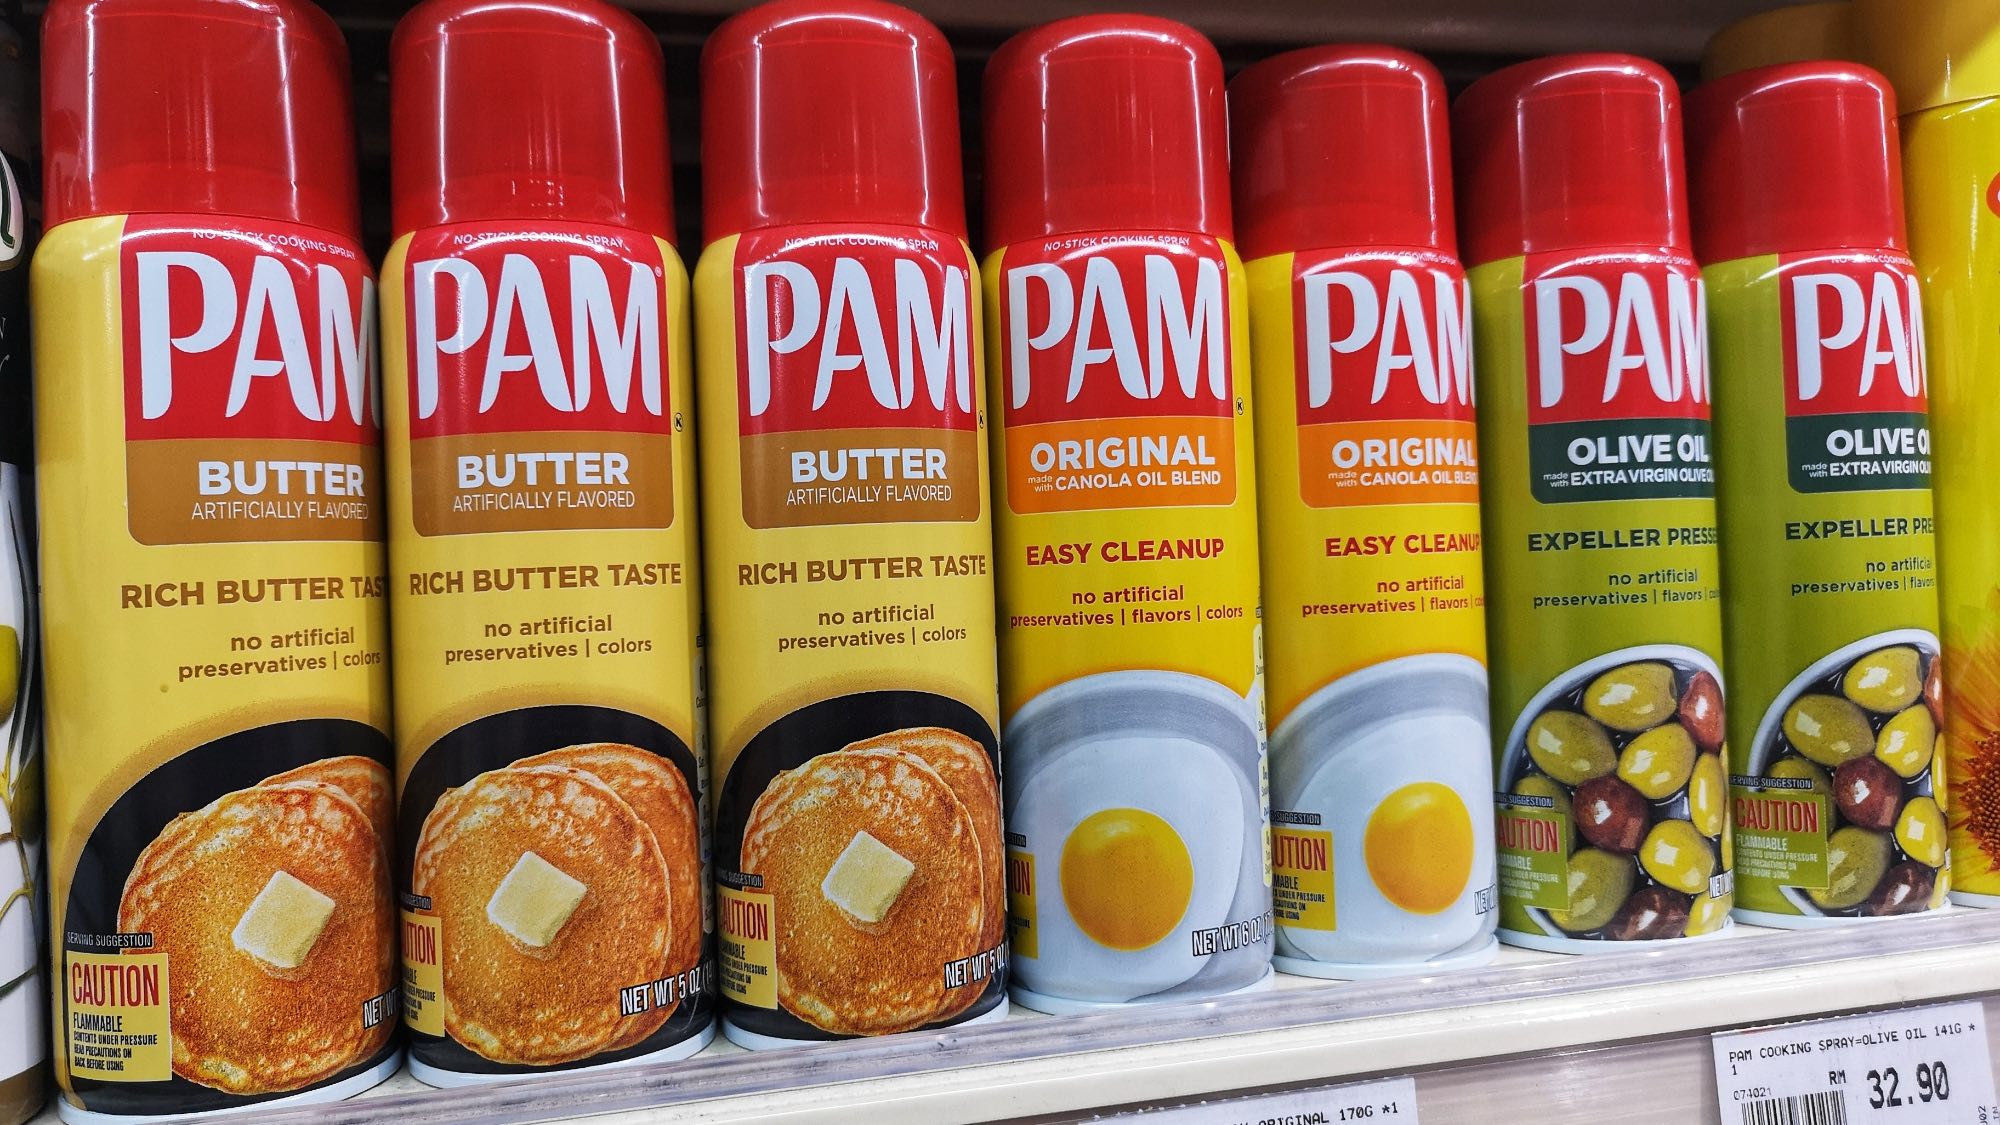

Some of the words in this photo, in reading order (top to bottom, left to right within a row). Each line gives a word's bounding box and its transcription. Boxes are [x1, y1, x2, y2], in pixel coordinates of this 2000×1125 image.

[268, 234, 327, 252] COOKING
[327, 244, 356, 260] SPRAY
[454, 232, 513, 245] NO-STICK
[585, 236, 624, 248] SPRAY
[908, 239, 939, 251] SPRAY
[1044, 237, 1097, 252] NO-STICK
[1100, 235, 1155, 246] COOKING
[1158, 235, 1189, 246] SPRAY
[136, 251, 381, 429] PAM
[413, 253, 662, 420] PAM
[743, 257, 971, 416] PAM
[1007, 254, 1226, 410] PAM
[1303, 269, 1476, 408] PAM
[1534, 272, 1711, 408] PAM
[1030, 435, 1216, 473] ORIGINAL
[1331, 437, 1477, 469] ORIGINAL
[1567, 434, 1672, 465] OLIVE
[1676, 434, 1710, 463] OIL
[1826, 428, 1915, 457] OLIVE
[457, 452, 630, 489] BUTTER
[791, 448, 947, 483] BUTTER
[1328, 471, 1357, 479] made
[1543, 471, 1568, 480] made
[1571, 470, 1630, 486] EXTRA
[1629, 468, 1678, 484] VIRGIN
[1679, 467, 1707, 482] OLIVE
[1801, 462, 1828, 470] made
[1809, 470, 1828, 478] with
[1829, 461, 1884, 477] EXTRA
[1883, 460, 1919, 474] VIRGIN
[198, 460, 366, 497] BUTTER
[1028, 475, 1053, 485] made
[1034, 482, 1053, 493] with
[1055, 473, 1131, 491] CANOLA
[1136, 472, 1167, 487] OIL
[1171, 470, 1221, 486] BLEND
[1336, 479, 1357, 488] with
[1360, 471, 1429, 486] CANOLA
[1432, 470, 1453, 484] OIL
[1550, 479, 1569, 488] with
[453, 492, 553, 512] ARTIFICIALLY
[557, 490, 635, 508] FLAVORED
[786, 486, 881, 506] ARTIFICIALLY
[886, 484, 952, 502] FLAVORED
[191, 501, 304, 520] ARTIFICIALLY
[307, 501, 368, 520] FLAVORED
[1528, 528, 1660, 552] EXPELLER
[1785, 517, 1908, 540] EXPELLER
[1026, 543, 1092, 566] EASY
[1101, 538, 1225, 562] CLEANUP
[1325, 535, 1396, 557] EASY
[1403, 533, 1480, 554] CLEANUP
[738, 561, 798, 585] RICH
[807, 556, 923, 582] BUTTER
[930, 555, 986, 576] TASTE
[1608, 574, 1632, 586] no
[1638, 569, 1698, 585] artificial
[1866, 561, 1886, 573] no
[409, 571, 464, 595] RICH
[473, 565, 599, 592] BUTTER
[607, 563, 682, 586] TASTE
[1376, 581, 1399, 593] no
[1405, 575, 1464, 591] artificial
[1791, 579, 1899, 596] preservatives
[121, 581, 204, 609] RICH
[216, 577, 344, 604] BUTTER
[1072, 591, 1096, 604] no
[1103, 585, 1184, 603] artificial
[1533, 591, 1648, 609] preservatives
[1663, 589, 1702, 602] flavors
[818, 611, 845, 626] no
[852, 603, 935, 624] artificial
[1010, 611, 1114, 629] preservatives
[1132, 608, 1191, 624] flavors
[1206, 604, 1243, 620] colors
[1302, 599, 1416, 617] preservatives
[1430, 596, 1468, 610] flavors
[484, 622, 512, 637] no
[519, 615, 612, 635] artificial
[231, 635, 262, 651] no
[270, 626, 355, 649] artificial
[778, 630, 905, 652] preservatives
[922, 626, 967, 642] colors
[445, 642, 578, 665] preservatives
[597, 638, 652, 655] colors
[178, 655, 327, 682] preservatives
[343, 650, 381, 666] colors
[1761, 777, 1811, 789] SUGGESTION
[1736, 797, 1819, 833] CAUTION
[1499, 815, 1560, 853] AUTION
[1272, 834, 1327, 871] UTION
[1296, 893, 1326, 903] PRESSURE
[67, 931, 94, 946] SERVING
[95, 934, 151, 947] SUGGESTION
[402, 920, 436, 966] UTION
[1192, 927, 1219, 957] NET
[1220, 923, 1240, 951] WT
[1241, 920, 1249, 946] 6
[1250, 916, 1261, 943] OZ
[945, 958, 969, 988] NET
[971, 952, 988, 981] WT
[989, 949, 996, 974] 5
[996, 943, 1005, 970] OZ
[72, 961, 160, 1007] CAUTION
[621, 984, 650, 1016] NET
[653, 976, 675, 1007] WT
[678, 972, 687, 999] 5
[688, 966, 701, 995] OZ
[73, 1011, 123, 1033] FLAMMABLE
[363, 997, 384, 1028] NET
[99, 1034, 119, 1045] UNDER
[120, 1034, 158, 1045] PRESSURE
[1728, 1050, 1753, 1063] PAM
[1759, 1041, 1812, 1059] COOKING
[1905, 1027, 1927, 1040] OIL
[1934, 1023, 1962, 1037] 141G
[1731, 1064, 1738, 1076] 1
[1828, 1070, 1847, 1085] RM
[1733, 1087, 1772, 1101] 074021
[1866, 1060, 1950, 1109] 32.90
[1339, 1105, 1373, 1121] 170G
